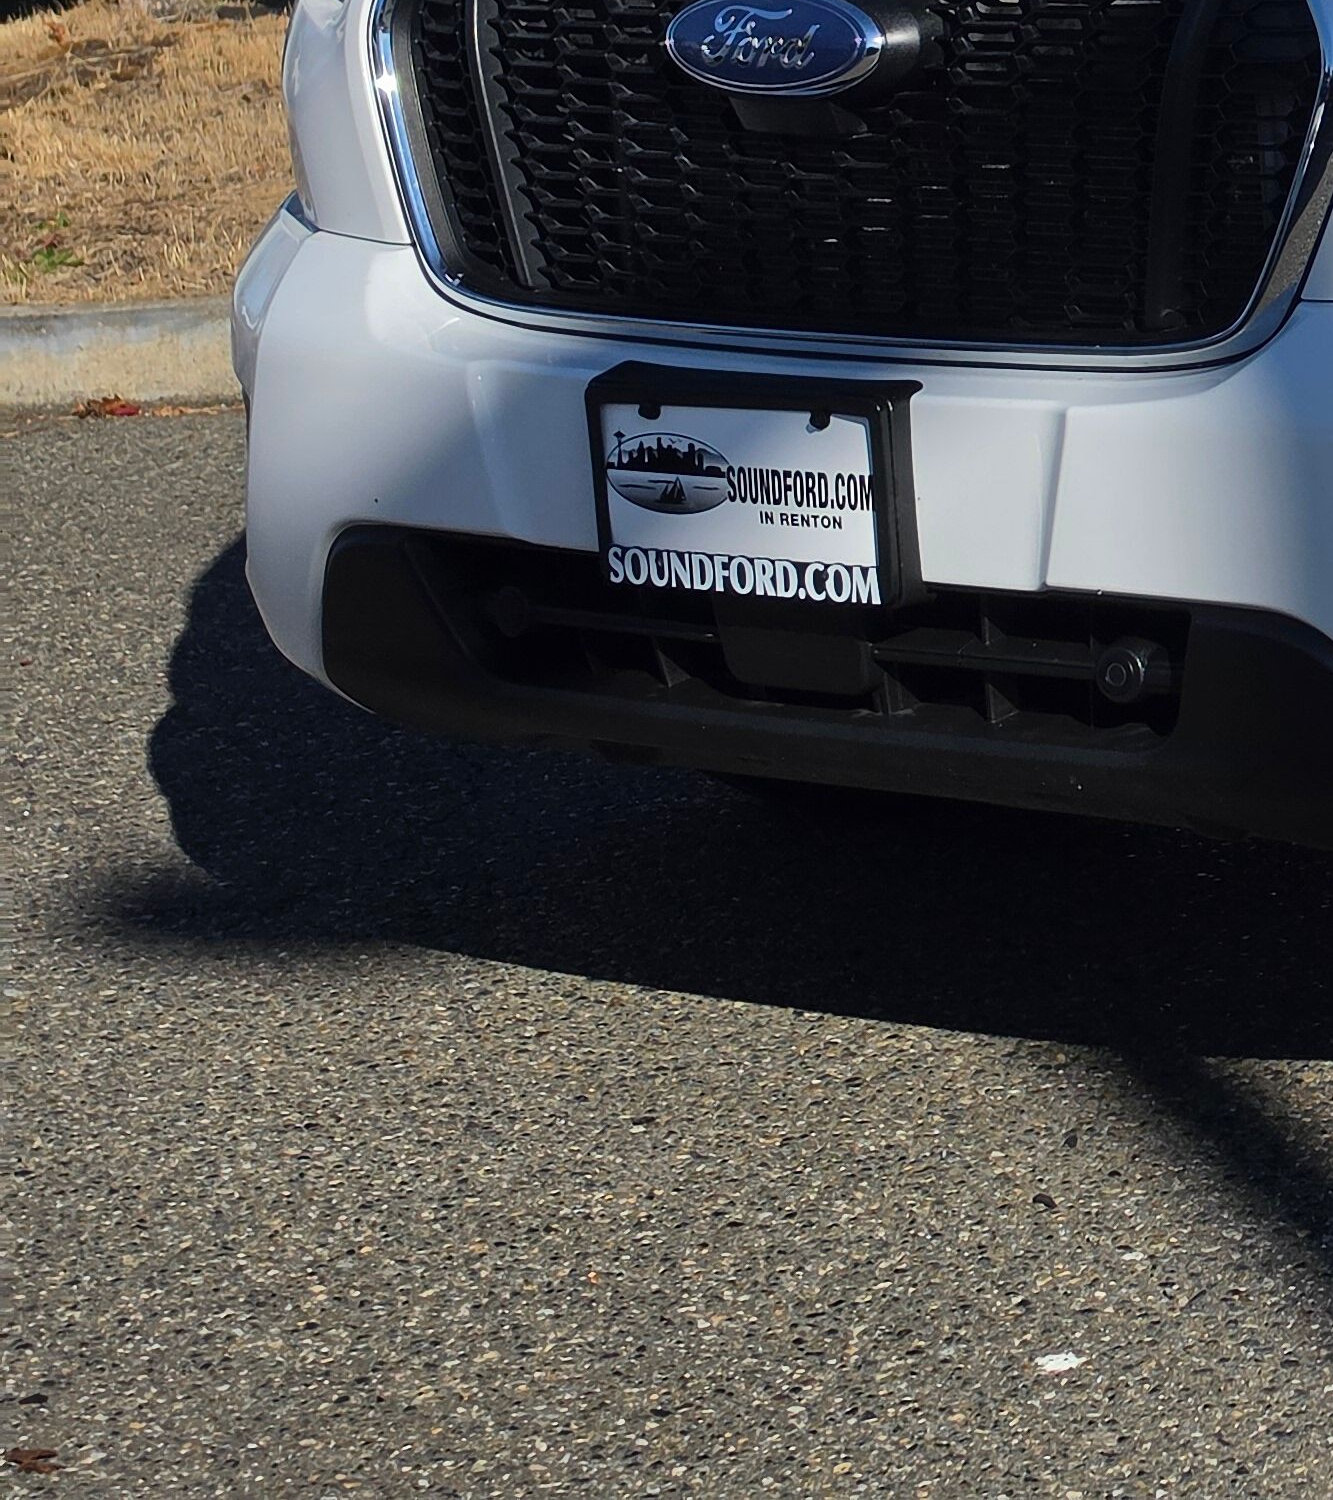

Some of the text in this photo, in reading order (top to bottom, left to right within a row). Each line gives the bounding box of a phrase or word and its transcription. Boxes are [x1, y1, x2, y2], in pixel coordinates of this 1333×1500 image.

[700, 5, 821, 70] Ford
[726, 466, 874, 512] SOUNDFORD.COM
[759, 510, 774, 525] IN
[780, 512, 843, 530] RENTON
[608, 546, 881, 605] SOUNDFORD.COM
